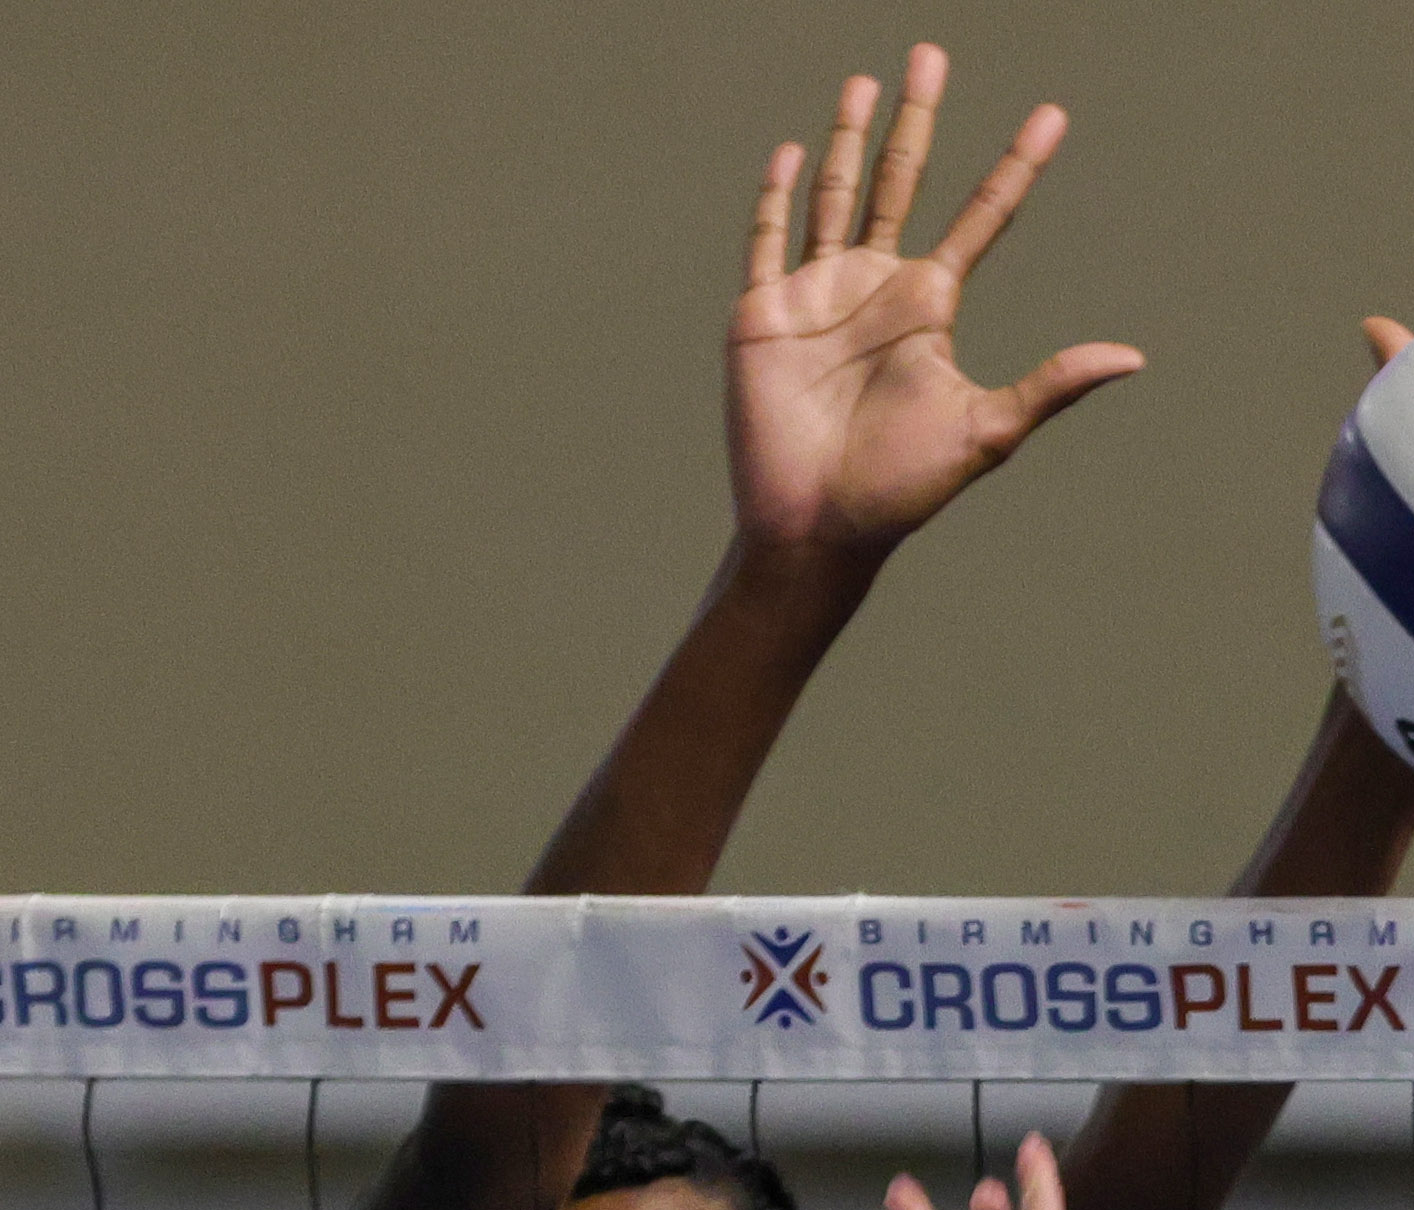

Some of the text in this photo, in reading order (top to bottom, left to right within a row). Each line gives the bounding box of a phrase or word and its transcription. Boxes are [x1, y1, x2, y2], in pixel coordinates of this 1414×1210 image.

[9, 917, 482, 943] IRMINGHAM
[859, 919, 1398, 947] BIRMINGHAM
[0, 959, 485, 1030] ROSSPLEX
[858, 961, 1405, 1032] CROSSPLEX
